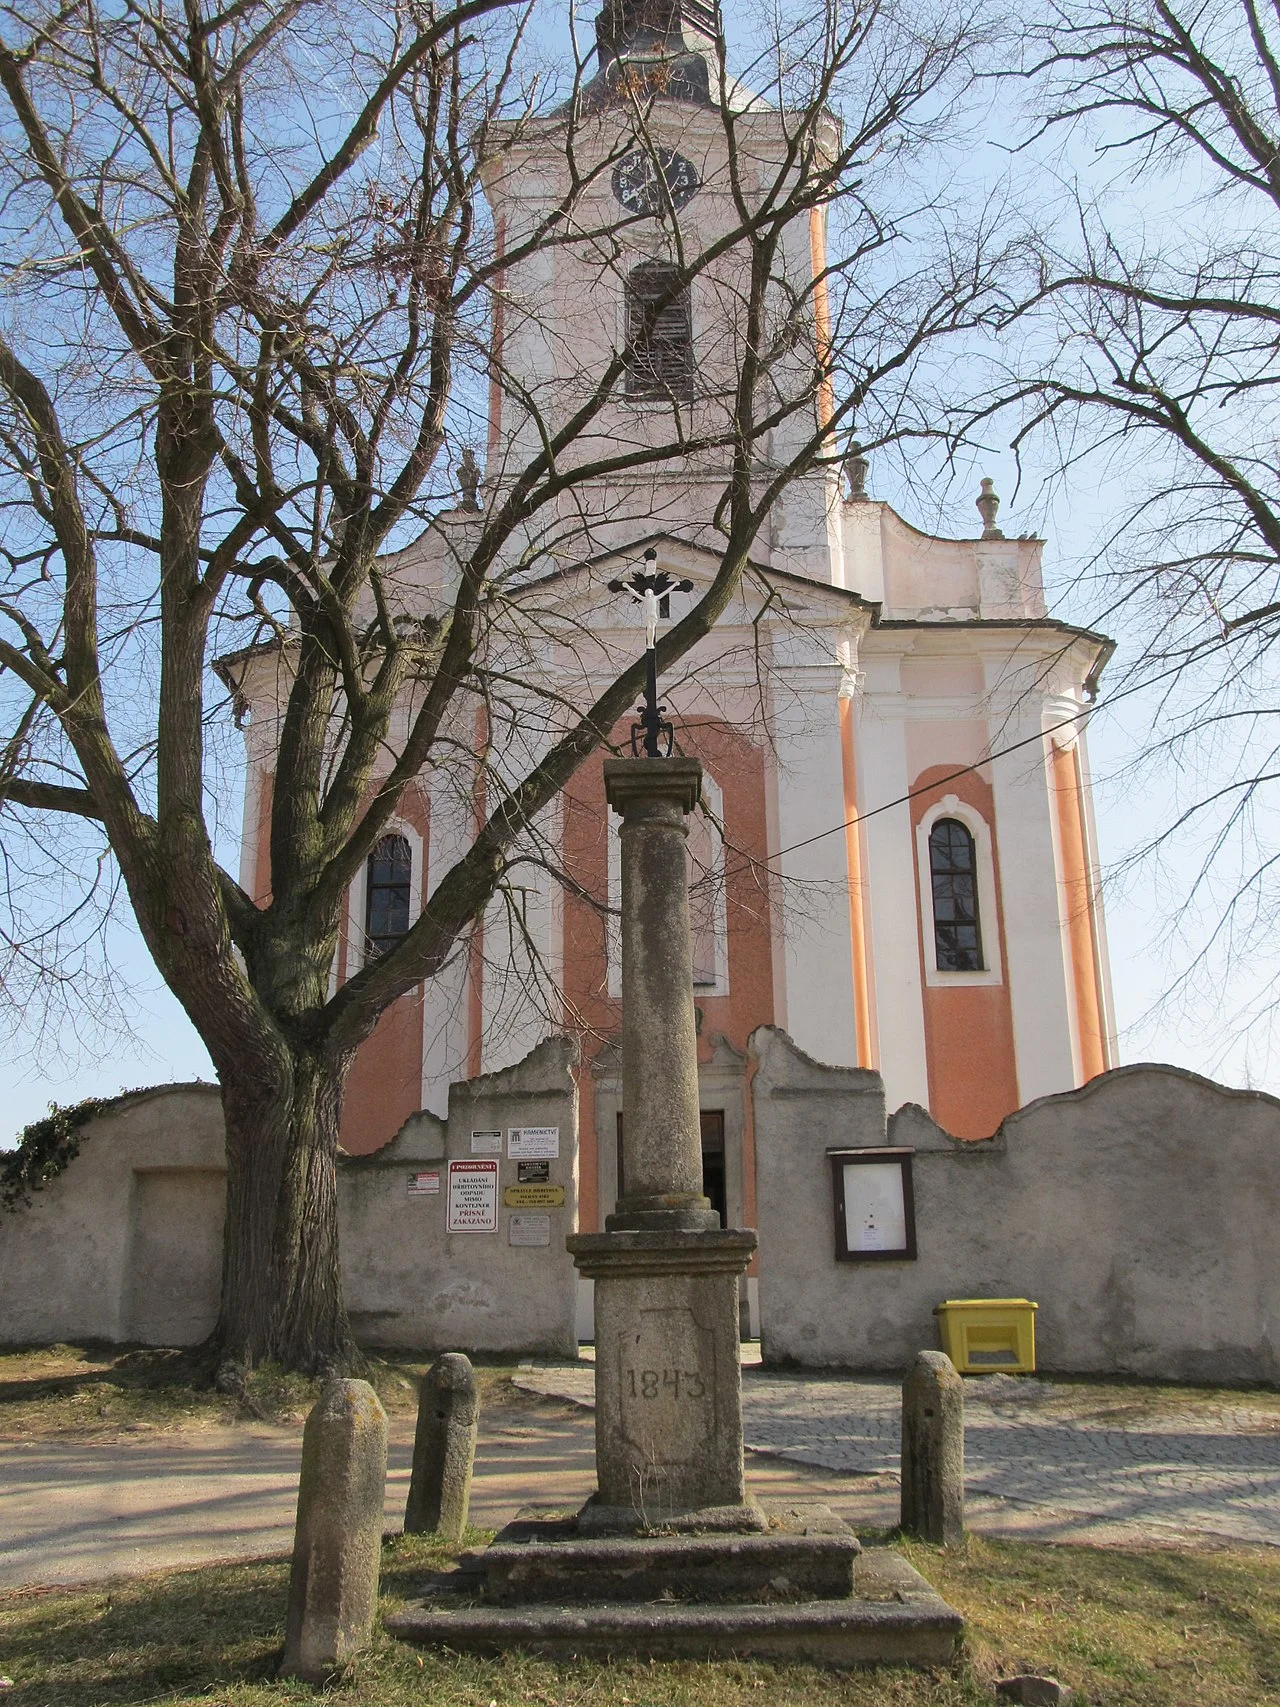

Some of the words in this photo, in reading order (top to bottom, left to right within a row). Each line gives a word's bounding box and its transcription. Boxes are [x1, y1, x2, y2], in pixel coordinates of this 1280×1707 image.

[678, 162, 686, 172] 2
[680, 175, 689, 186] 3
[523, 1128, 557, 1136] KAMENICTVÍ
[626, 1369, 706, 1401] 1843
